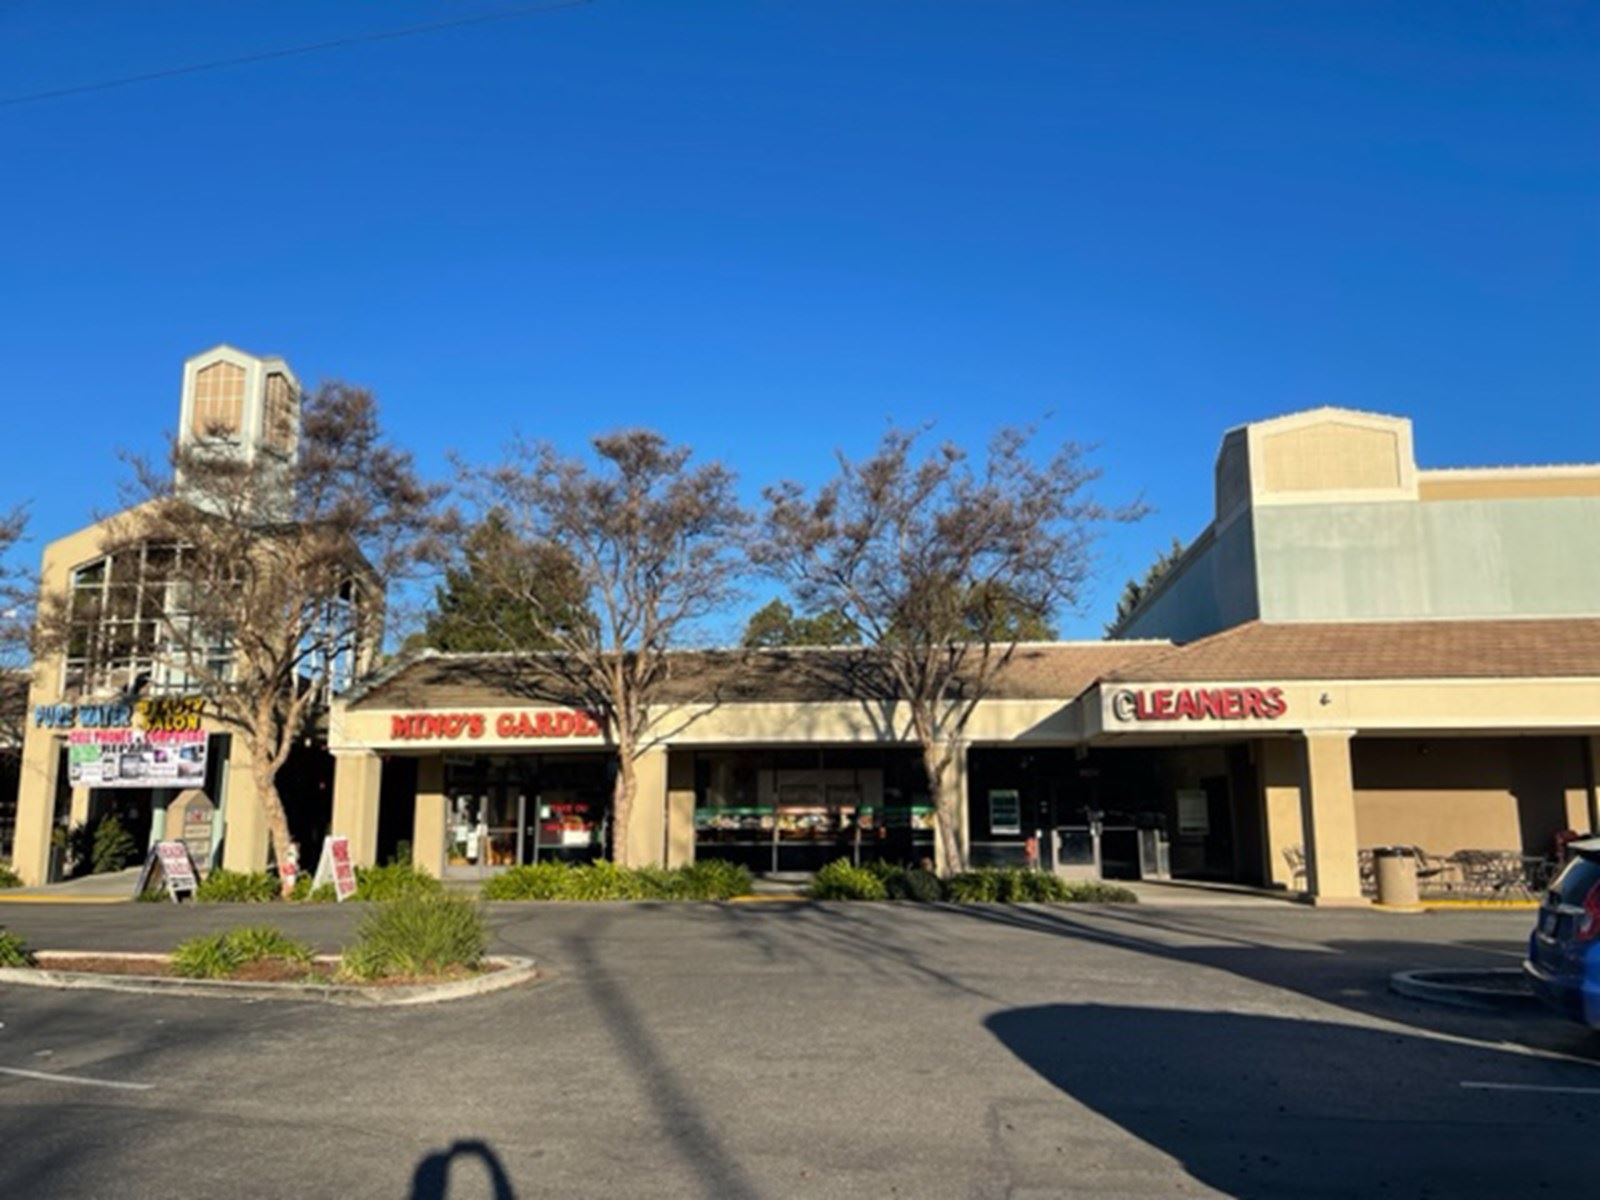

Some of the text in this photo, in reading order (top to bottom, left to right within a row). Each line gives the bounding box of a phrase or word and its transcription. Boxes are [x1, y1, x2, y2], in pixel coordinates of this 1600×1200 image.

[34, 704, 133, 728] PURE WATER
[1112, 687, 1288, 721] CLEANERS
[138, 713, 202, 732] SALON
[390, 712, 485, 740] MING'S
